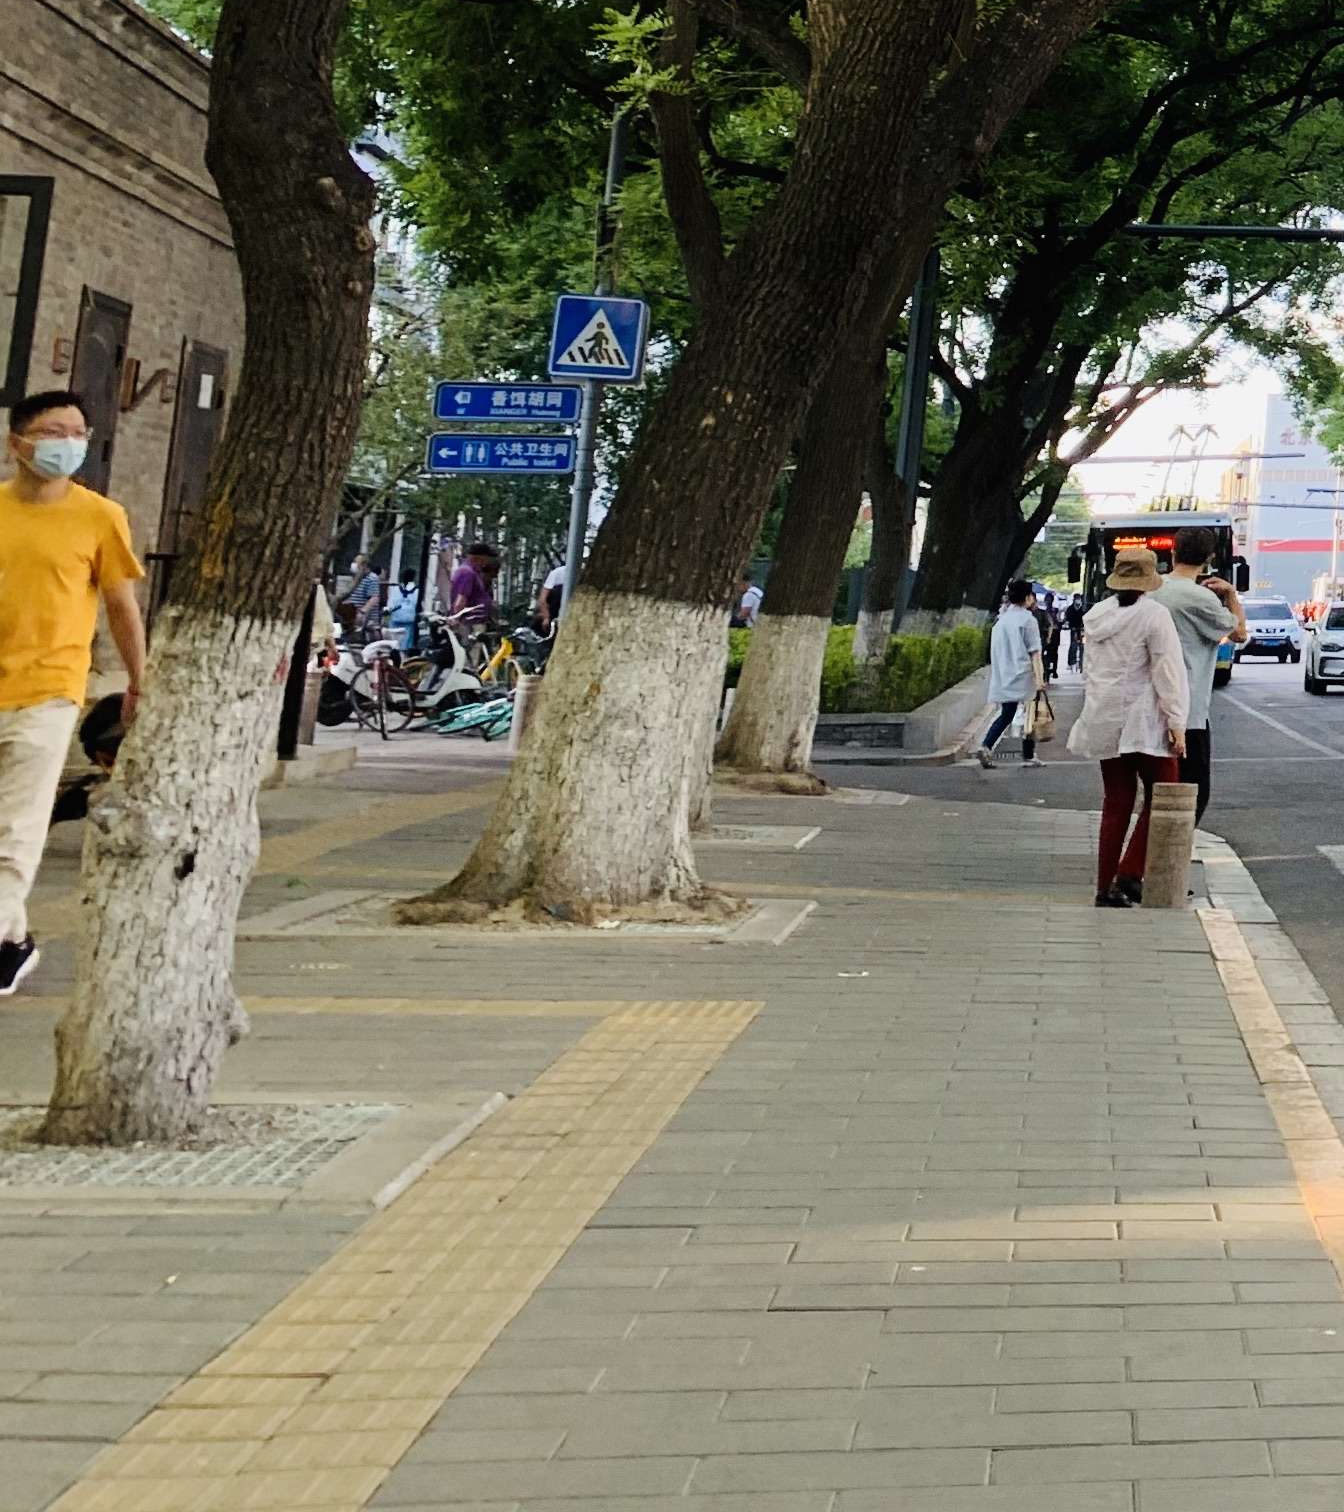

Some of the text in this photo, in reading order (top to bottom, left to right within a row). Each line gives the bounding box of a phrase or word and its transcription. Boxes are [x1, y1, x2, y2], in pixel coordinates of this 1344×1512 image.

[494, 442, 568, 457] 公共卫生间
